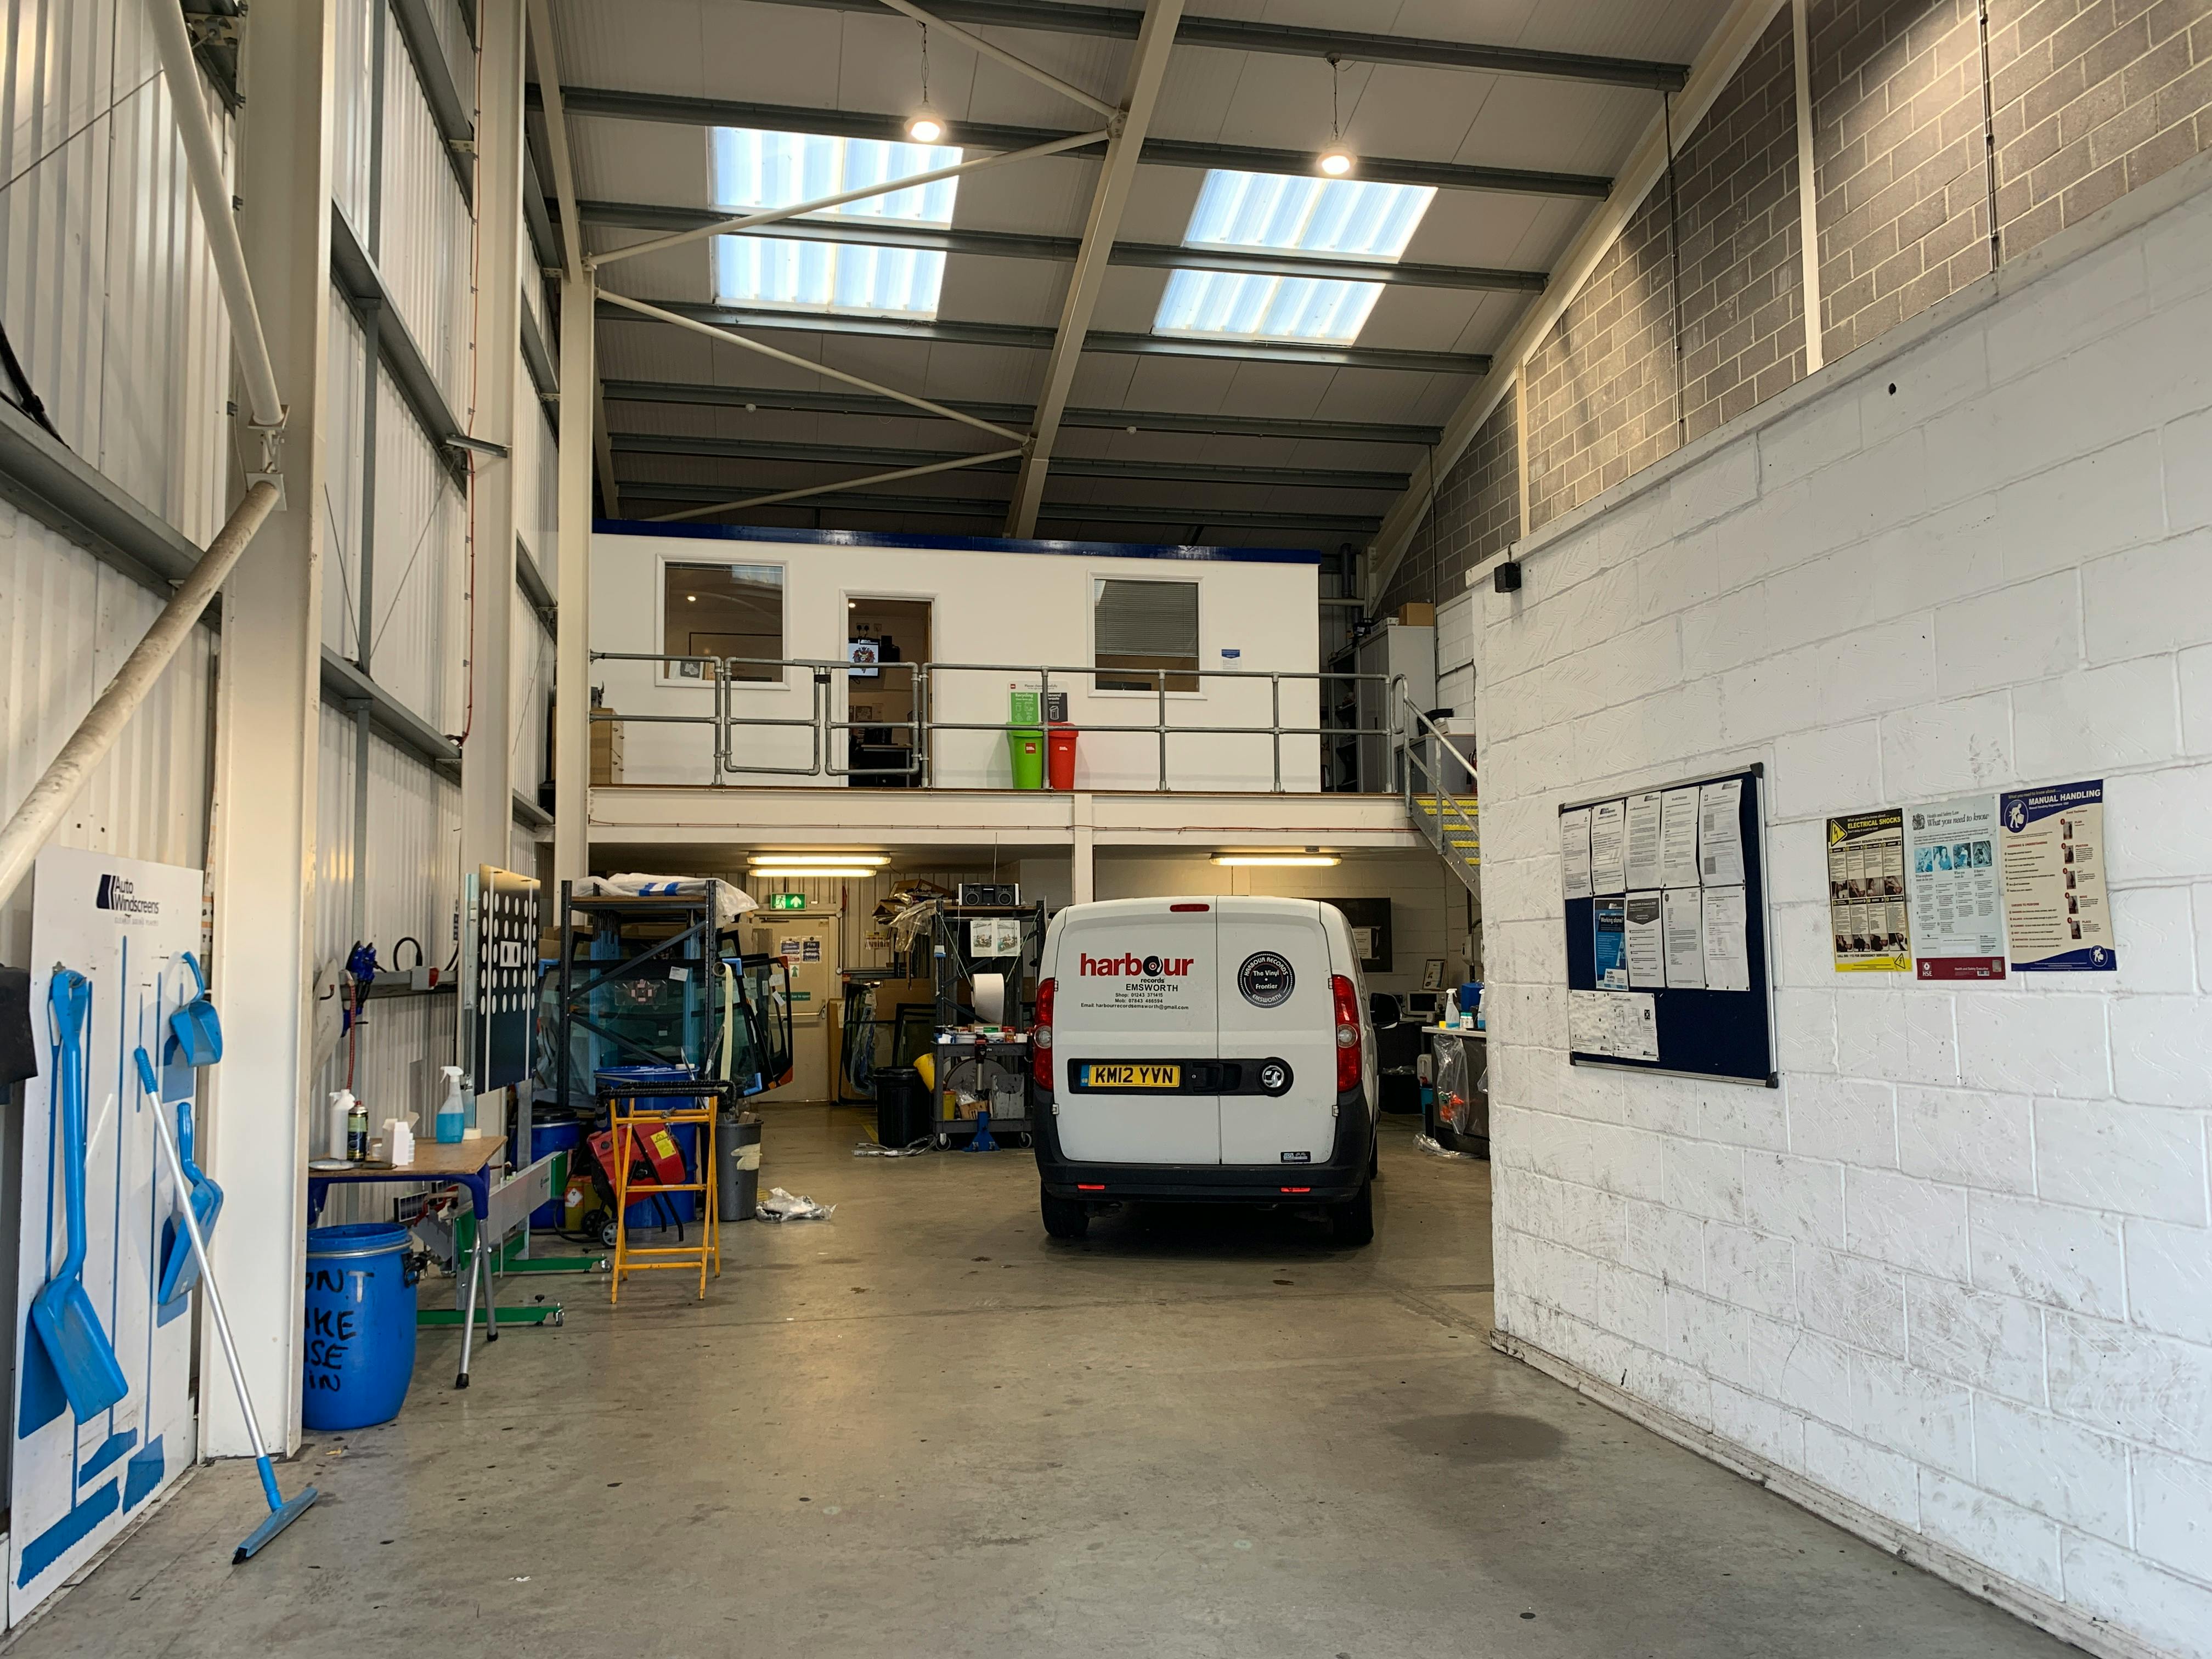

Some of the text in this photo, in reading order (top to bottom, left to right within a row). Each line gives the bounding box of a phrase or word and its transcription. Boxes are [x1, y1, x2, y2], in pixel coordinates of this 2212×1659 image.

[2029, 789, 2101, 805] MANUAL HANDLING
[1848, 816, 1901, 829] ELECTRICAL SHOCKS
[1953, 814, 1965, 823] need
[1973, 812, 1989, 821] know
[115, 876, 133, 894] Auto
[114, 894, 159, 914] Windscreens
[1080, 952, 1194, 977] harbour
[1244, 957, 1288, 977] HARBOUR RECORDS
[1126, 984, 1178, 992] EMSWORTH
[1252, 994, 1282, 1003] EMSWORTH
[1095, 1067, 1173, 1084] KM12 YVN
